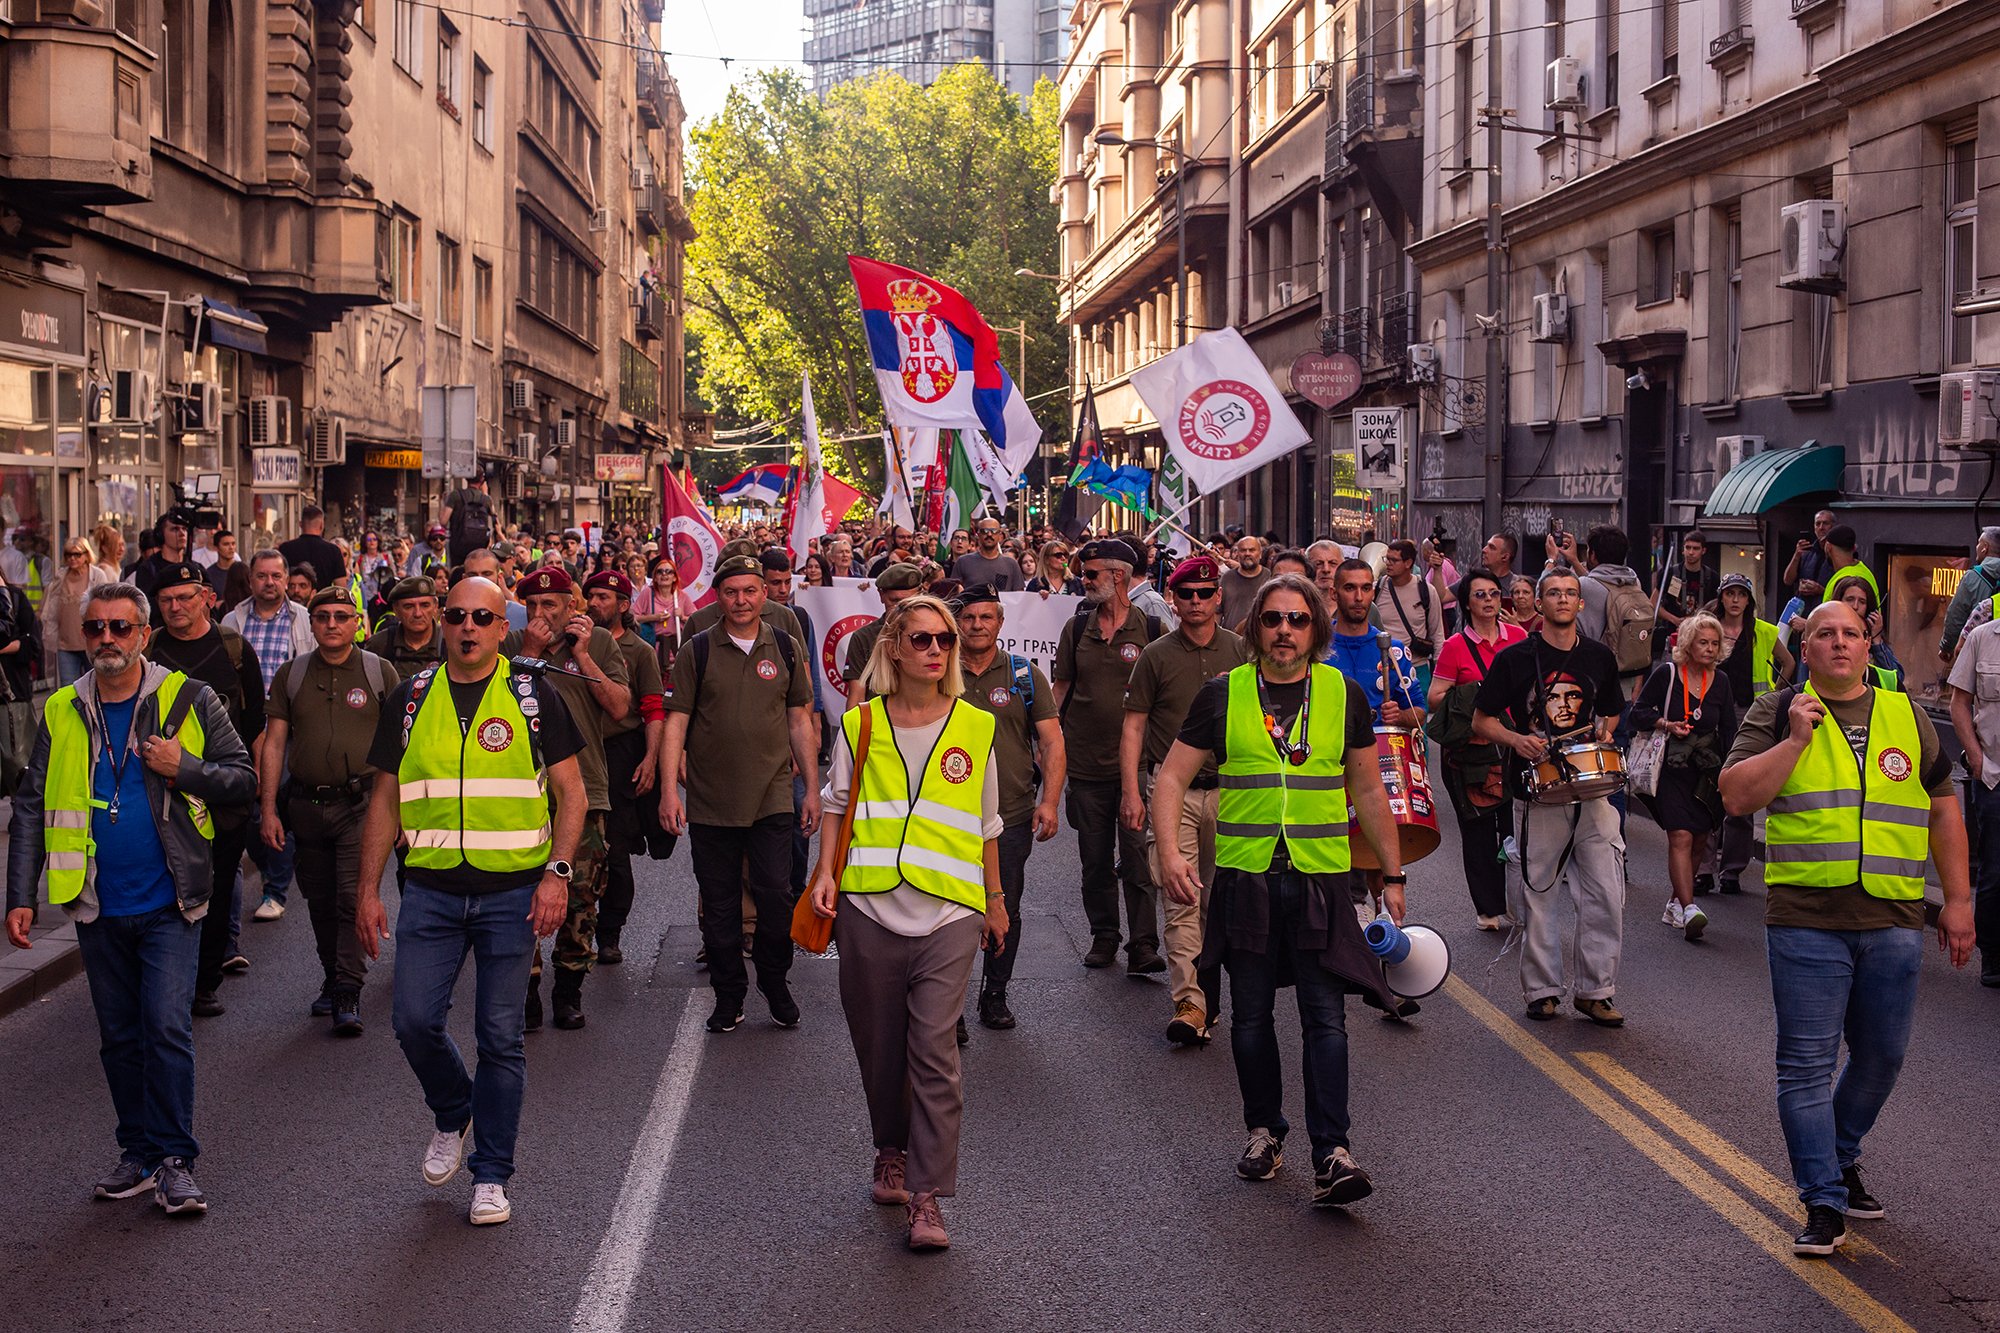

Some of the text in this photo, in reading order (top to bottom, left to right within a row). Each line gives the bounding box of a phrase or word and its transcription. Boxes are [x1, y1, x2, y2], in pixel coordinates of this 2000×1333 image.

[1311, 362, 1344, 371] УЛИЦА
[1299, 374, 1355, 383] ОТВОРЕНОГ
[1312, 386, 1342, 397] СРЦА
[1361, 414, 1393, 426] ЗОНА
[1359, 428, 1397, 440] ШКОЛЕ
[367, 452, 385, 465] PAZI
[597, 455, 643, 467] ПЕКАРА
[275, 456, 299, 481] FRIZER
[692, 526, 713, 577] ГРАЂАНА
[827, 622, 848, 647] ЗБОР
[828, 668, 849, 695] СТА
